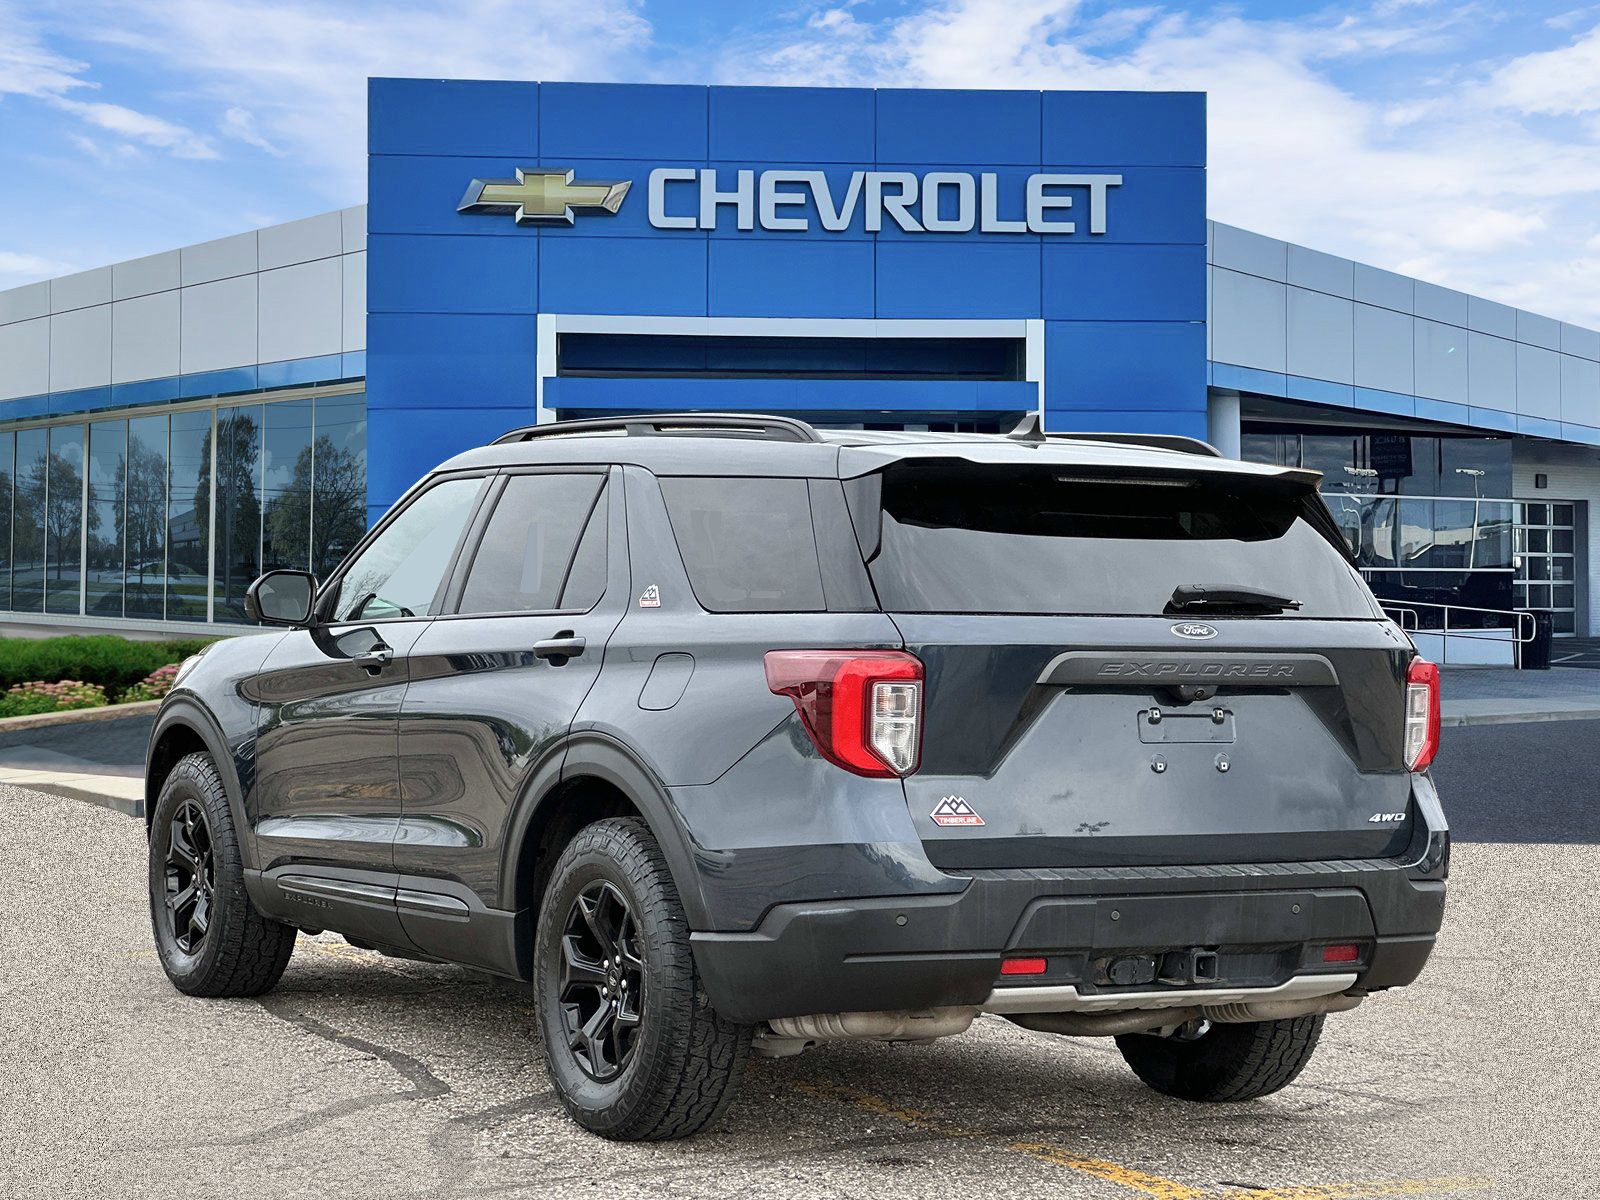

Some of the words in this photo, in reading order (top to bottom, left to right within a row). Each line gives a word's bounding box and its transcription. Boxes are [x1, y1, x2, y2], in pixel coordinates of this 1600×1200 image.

[648, 168, 1123, 233] CHEVROLET
[1183, 625, 1208, 635] Ford
[1097, 662, 1295, 677] EXPLORER
[1368, 812, 1406, 822] 4WD
